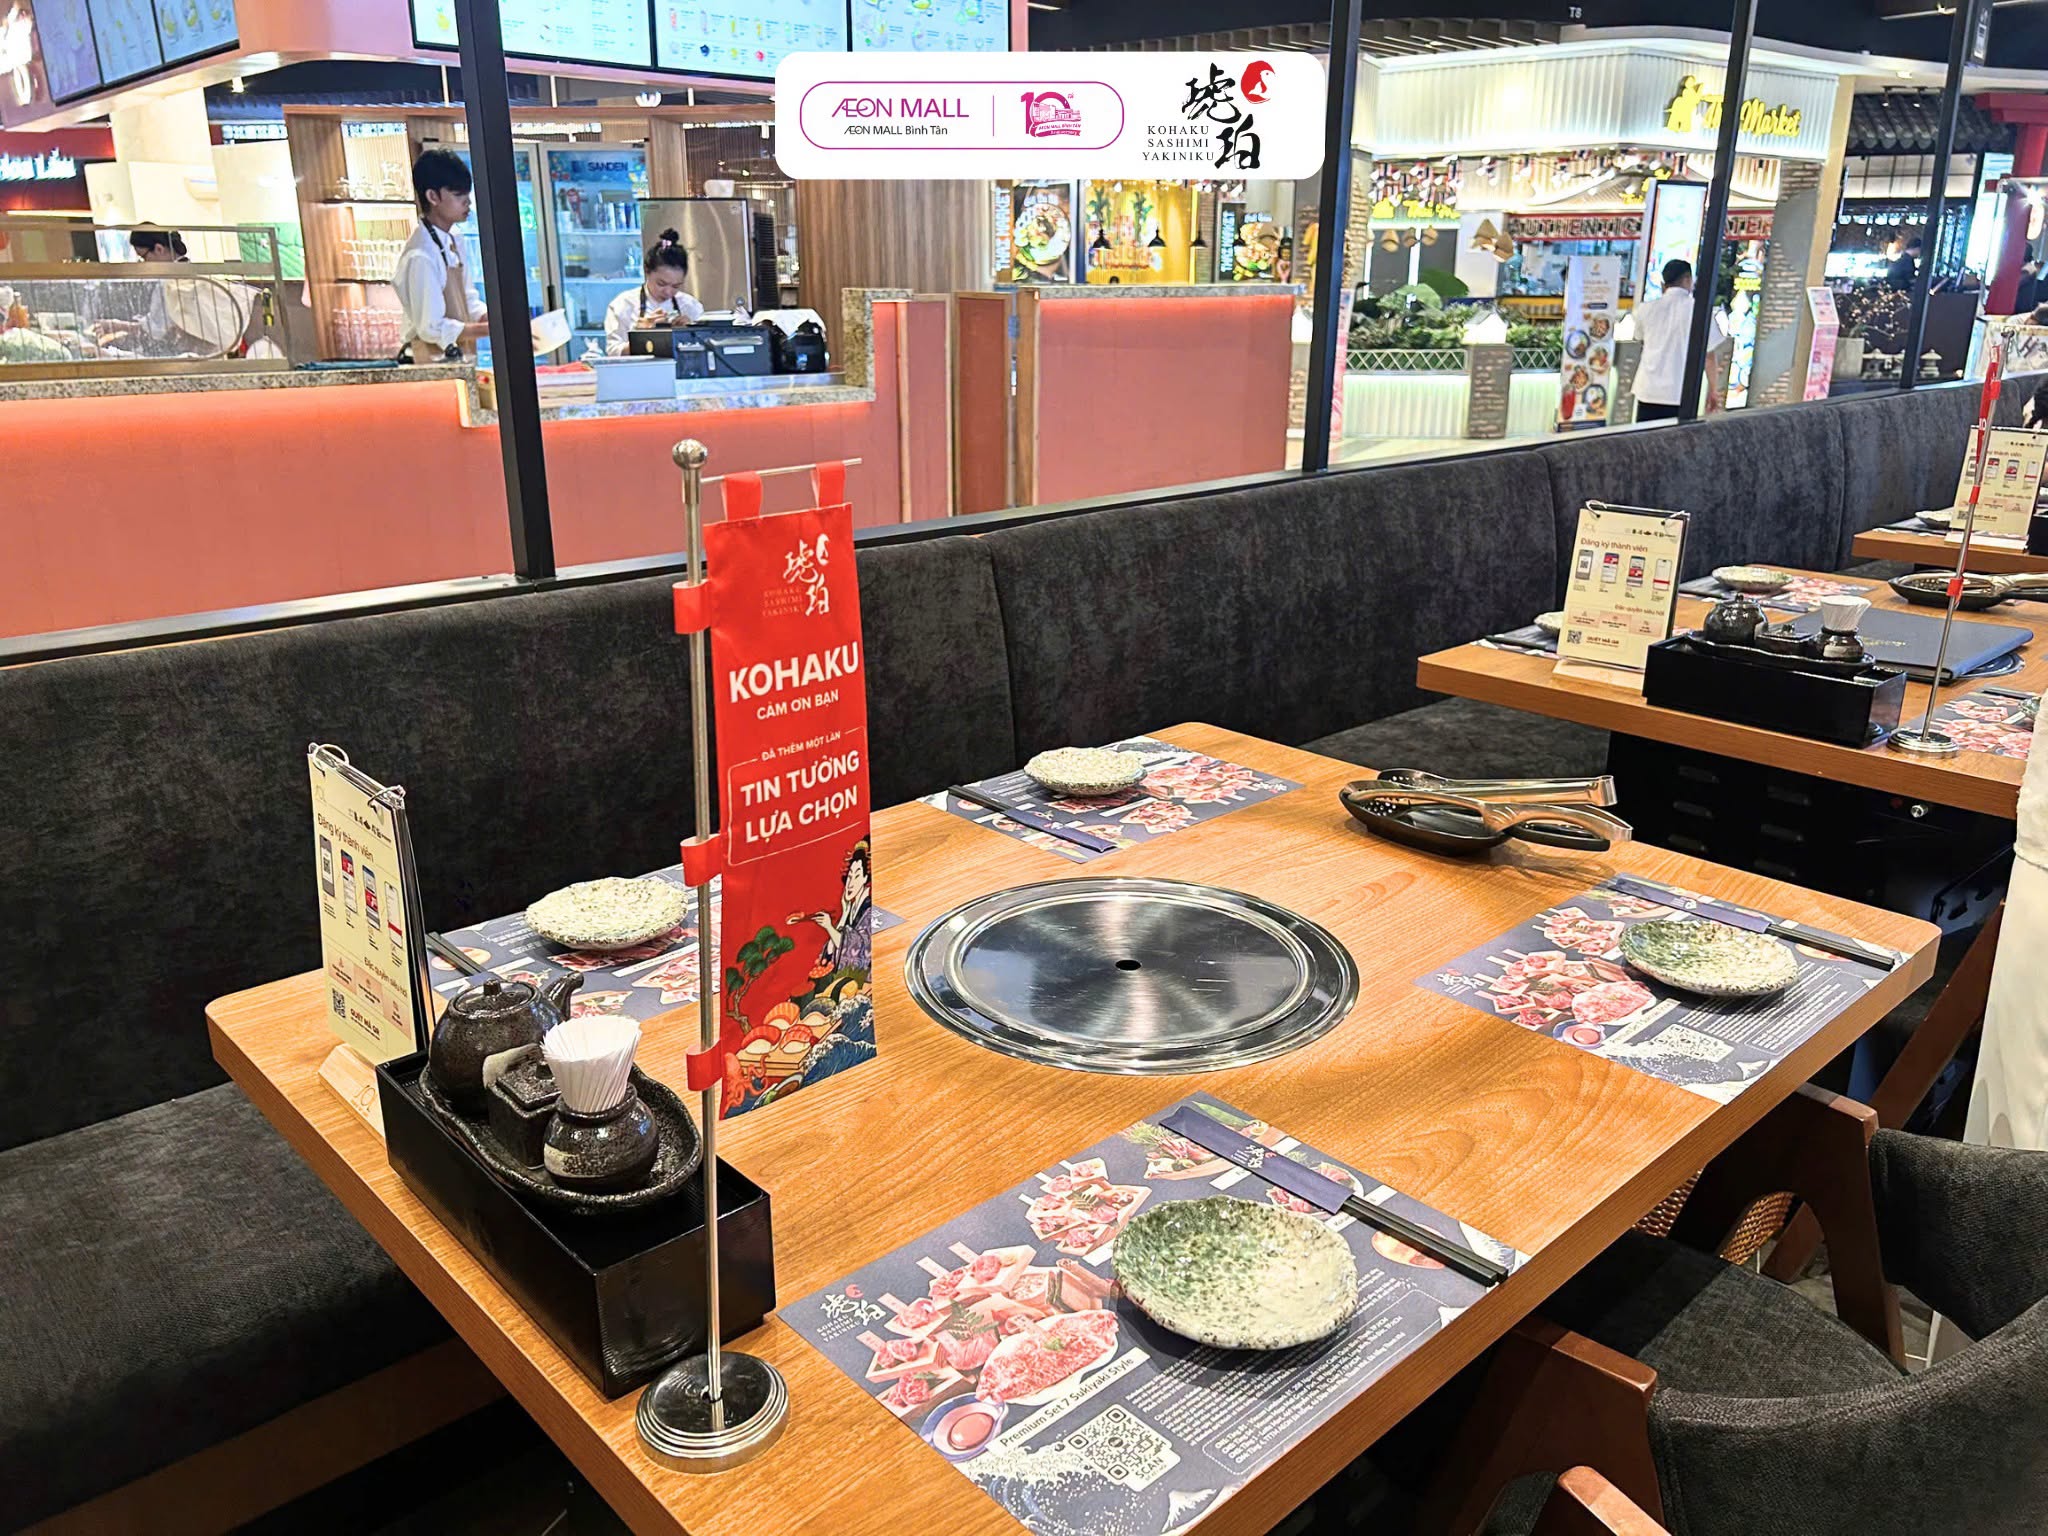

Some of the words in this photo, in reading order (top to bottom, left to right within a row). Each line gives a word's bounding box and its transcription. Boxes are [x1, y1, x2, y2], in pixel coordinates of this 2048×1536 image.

[1740, 97, 1800, 137] Market
[587, 161, 628, 172] SANDEN
[1507, 217, 1641, 237] AUTHENTIC
[729, 641, 859, 703] KOHAKU
[757, 701, 788, 720] CẢM
[815, 689, 839, 707] BẠN
[777, 742, 804, 757] THÊM
[806, 735, 825, 749] MỘT
[740, 775, 781, 807] TIN
[786, 750, 860, 793] TƯỞNG
[745, 809, 793, 843] LỰA
[799, 784, 858, 825] CHỌN
[1000, 1415, 1047, 1446] Premium
[1049, 1404, 1064, 1417] Set
[1064, 1399, 1071, 1407] 7
[1069, 1373, 1111, 1399] Sukiyaki
[1109, 1357, 1135, 1376] Style
[1135, 1457, 1164, 1478] SCAN
